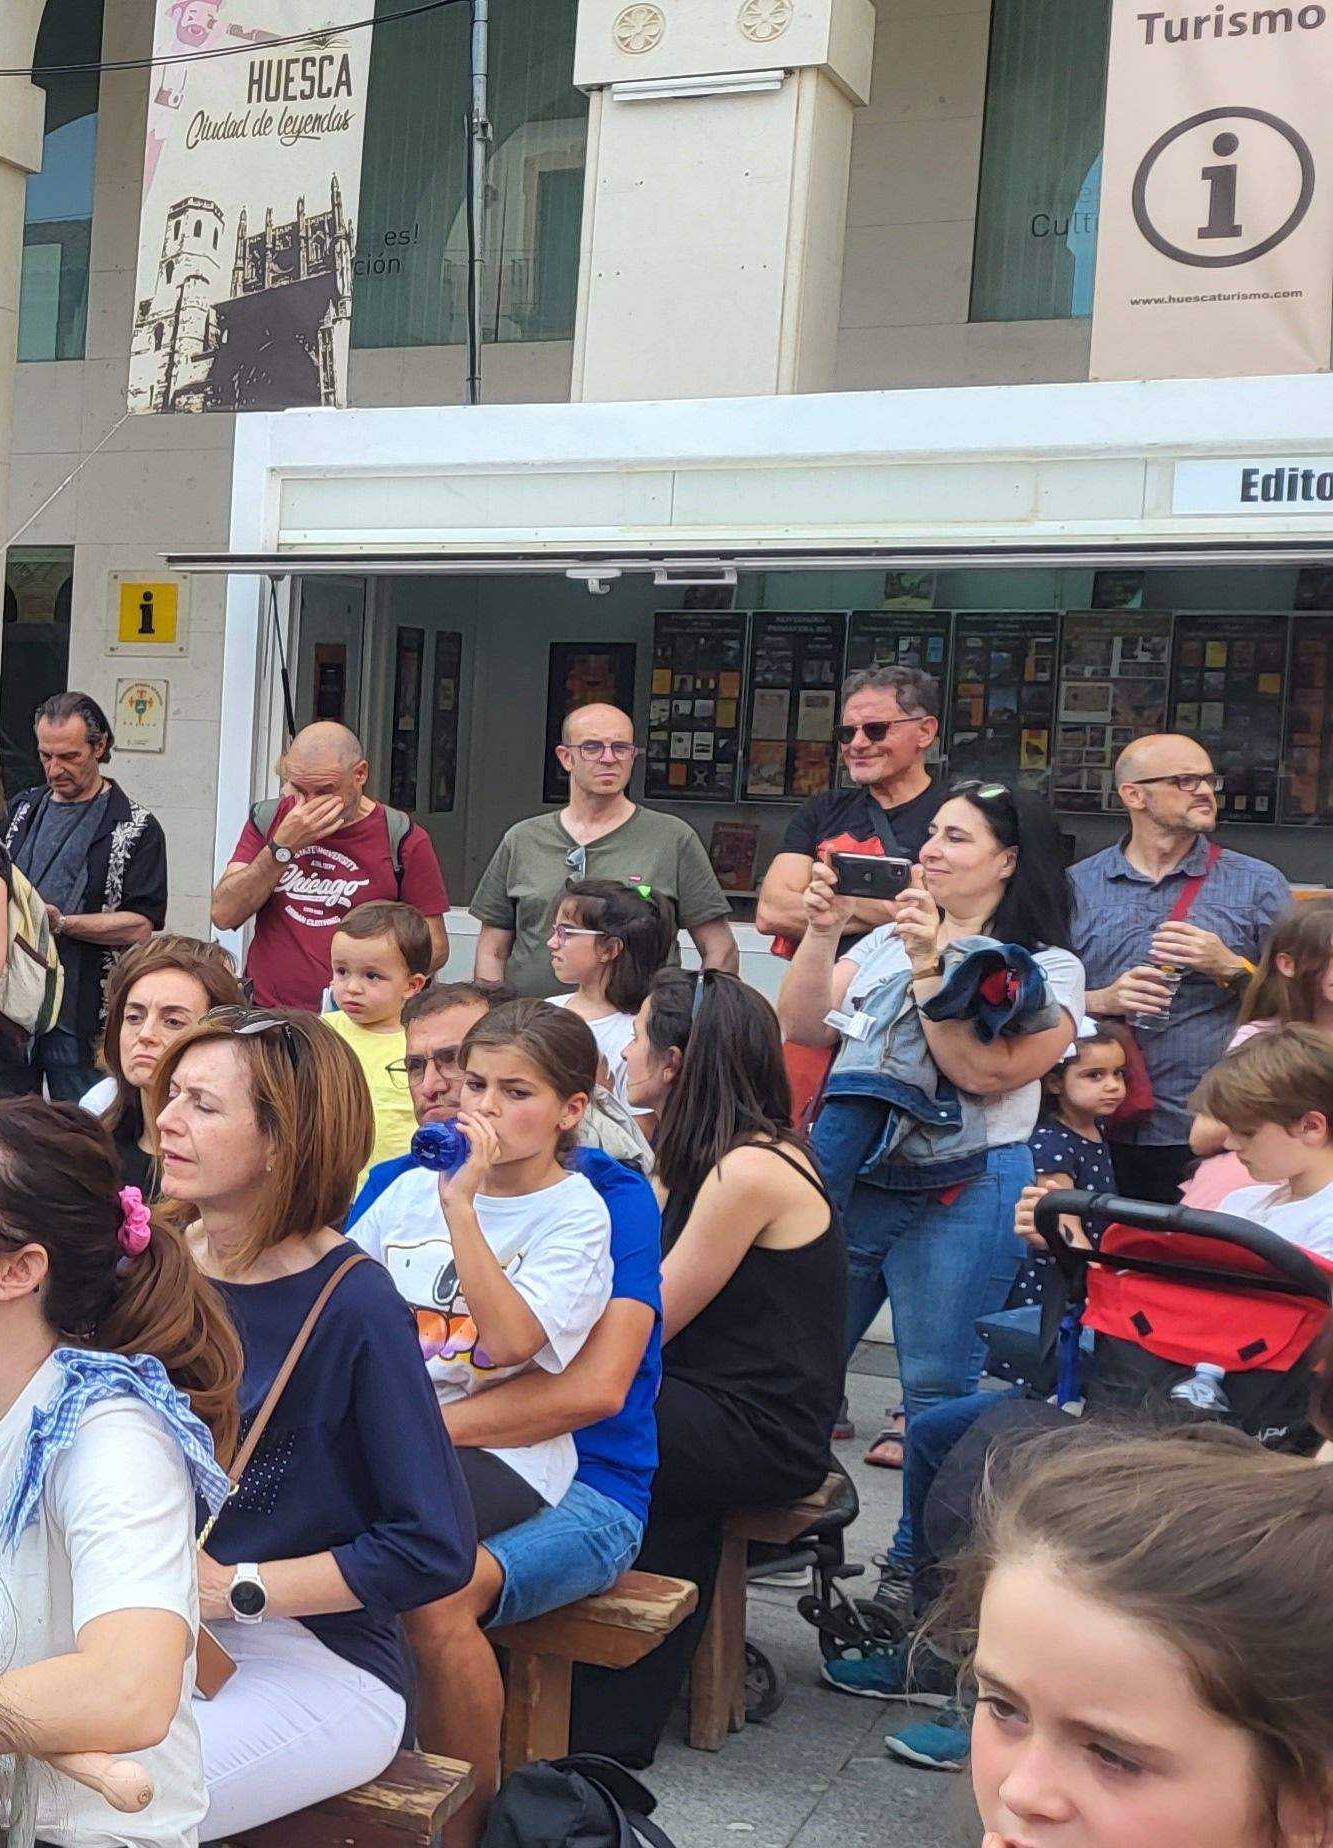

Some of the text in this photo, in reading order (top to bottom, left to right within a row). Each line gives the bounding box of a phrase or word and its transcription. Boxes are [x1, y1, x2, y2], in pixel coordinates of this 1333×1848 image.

[1136, 4, 1327, 45] Turismo
[247, 53, 353, 104] HUESCA
[185, 104, 356, 150] Ciudad de leyendas
[384, 223, 419, 246] es!
[1129, 289, 1303, 306] www.huescaturismo.com
[1240, 467, 1333, 502] Edito
